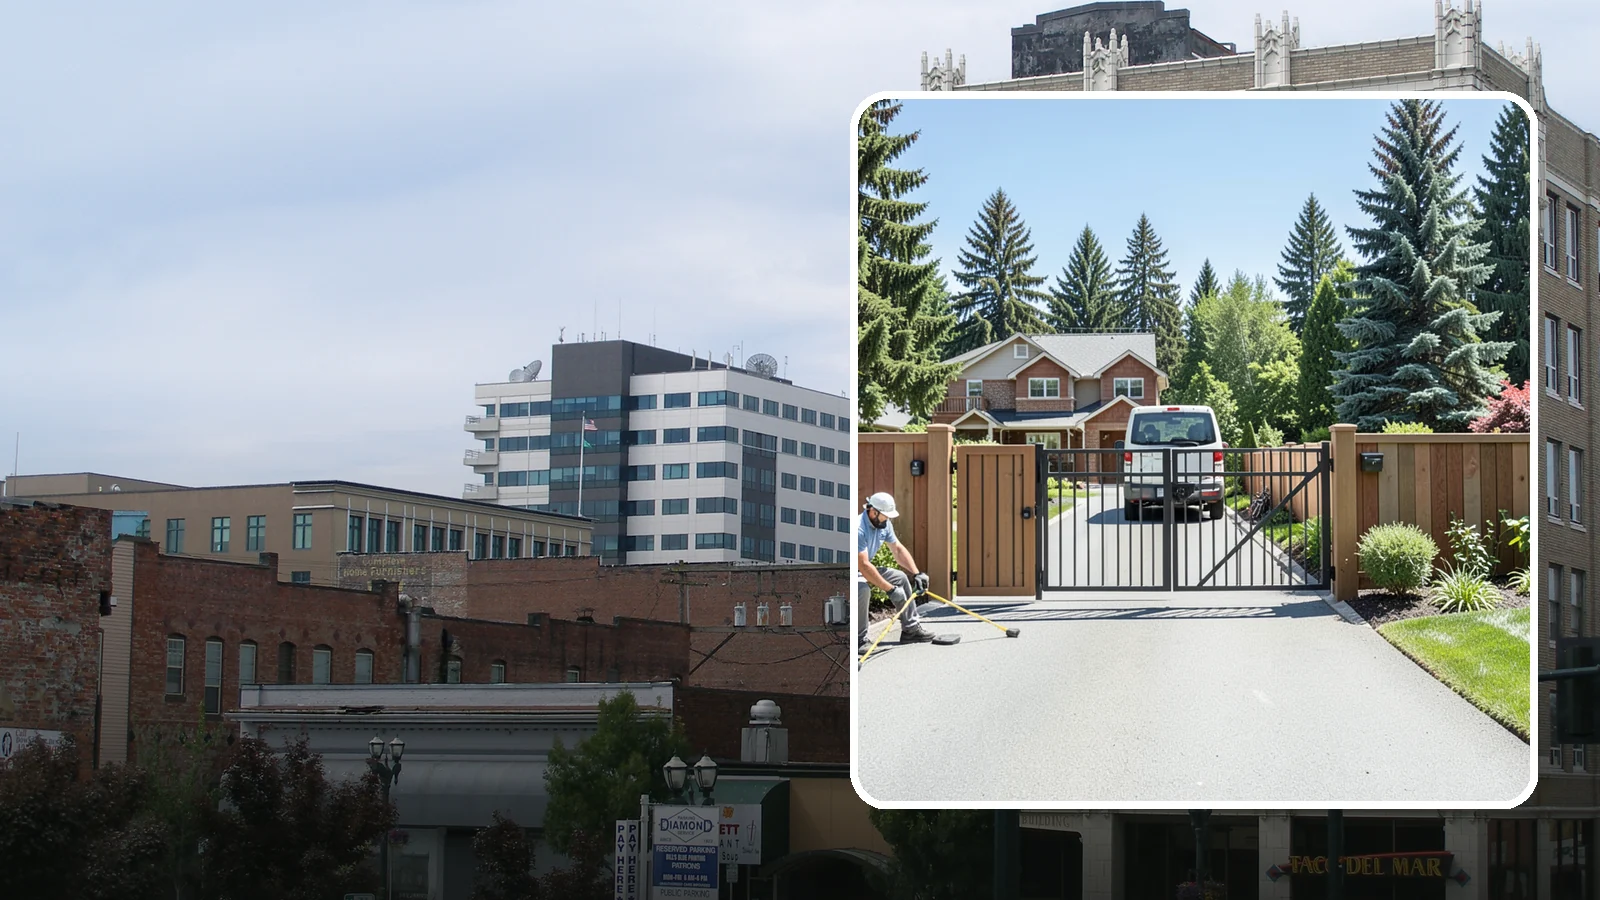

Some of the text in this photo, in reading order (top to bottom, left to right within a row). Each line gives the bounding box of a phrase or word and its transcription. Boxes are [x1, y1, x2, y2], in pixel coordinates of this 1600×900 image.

[370, 566, 428, 577] Furnishers
[1021, 815, 1070, 828] BUILDING
[655, 845, 717, 854] RESERVED PARKING
[616, 824, 625, 893] PAY HERE
[627, 824, 637, 893] PAY HERE
[721, 852, 739, 862] Soup
[671, 862, 701, 870] PATRONS
[1289, 855, 1443, 877] TAC DEL MAR
[660, 888, 710, 899] PUBLIC PARKING
